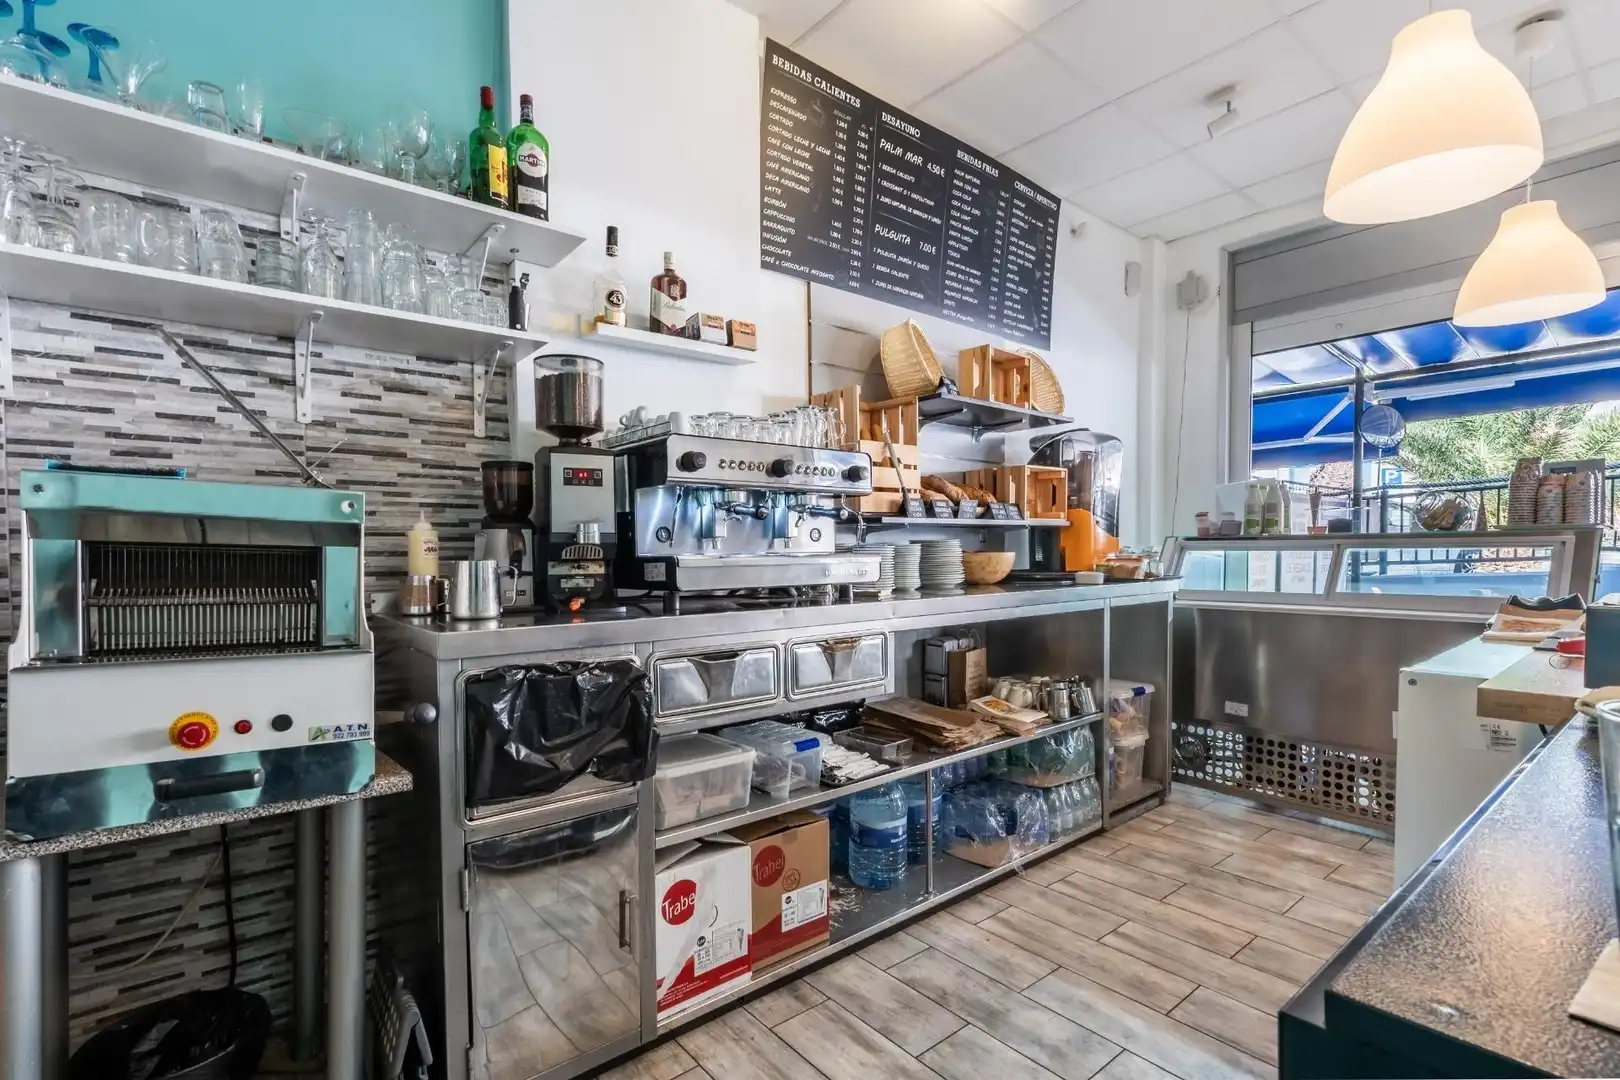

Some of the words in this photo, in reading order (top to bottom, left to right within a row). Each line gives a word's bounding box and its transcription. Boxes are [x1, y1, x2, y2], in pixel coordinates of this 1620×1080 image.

[772, 54, 812, 82] BEBIDAS
[814, 77, 860, 108] CALIENTES
[770, 88, 797, 104] EXPRESSO
[770, 100, 807, 121] DESCAFEINADO
[769, 112, 793, 127] CORTADO
[882, 112, 920, 138] DESAYUNO
[768, 124, 792, 140] CORTADO
[794, 135, 810, 147] LECHE
[782, 142, 793, 152] CON
[880, 138, 903, 157] PALM
[904, 152, 923, 166] MAR
[766, 148, 792, 163] CORTADO
[792, 158, 814, 172] VEGETAL
[956, 149, 982, 169] BEBIDAS
[780, 166, 810, 182] AMERICANO
[764, 184, 782, 195] LATTE
[780, 178, 810, 194] AMERICANO
[763, 208, 796, 224] CAPPUCCINO
[762, 220, 796, 236] BARRAQUITO
[874, 224, 911, 245] PULGUITA
[762, 244, 792, 258] CHOCOLATE
[780, 260, 810, 274] CHOCOLATE
[609, 292, 622, 307] 43
[1385, 470, 1398, 484] P
[753, 856, 785, 881] Trabel
[662, 892, 697, 921] Trabe
